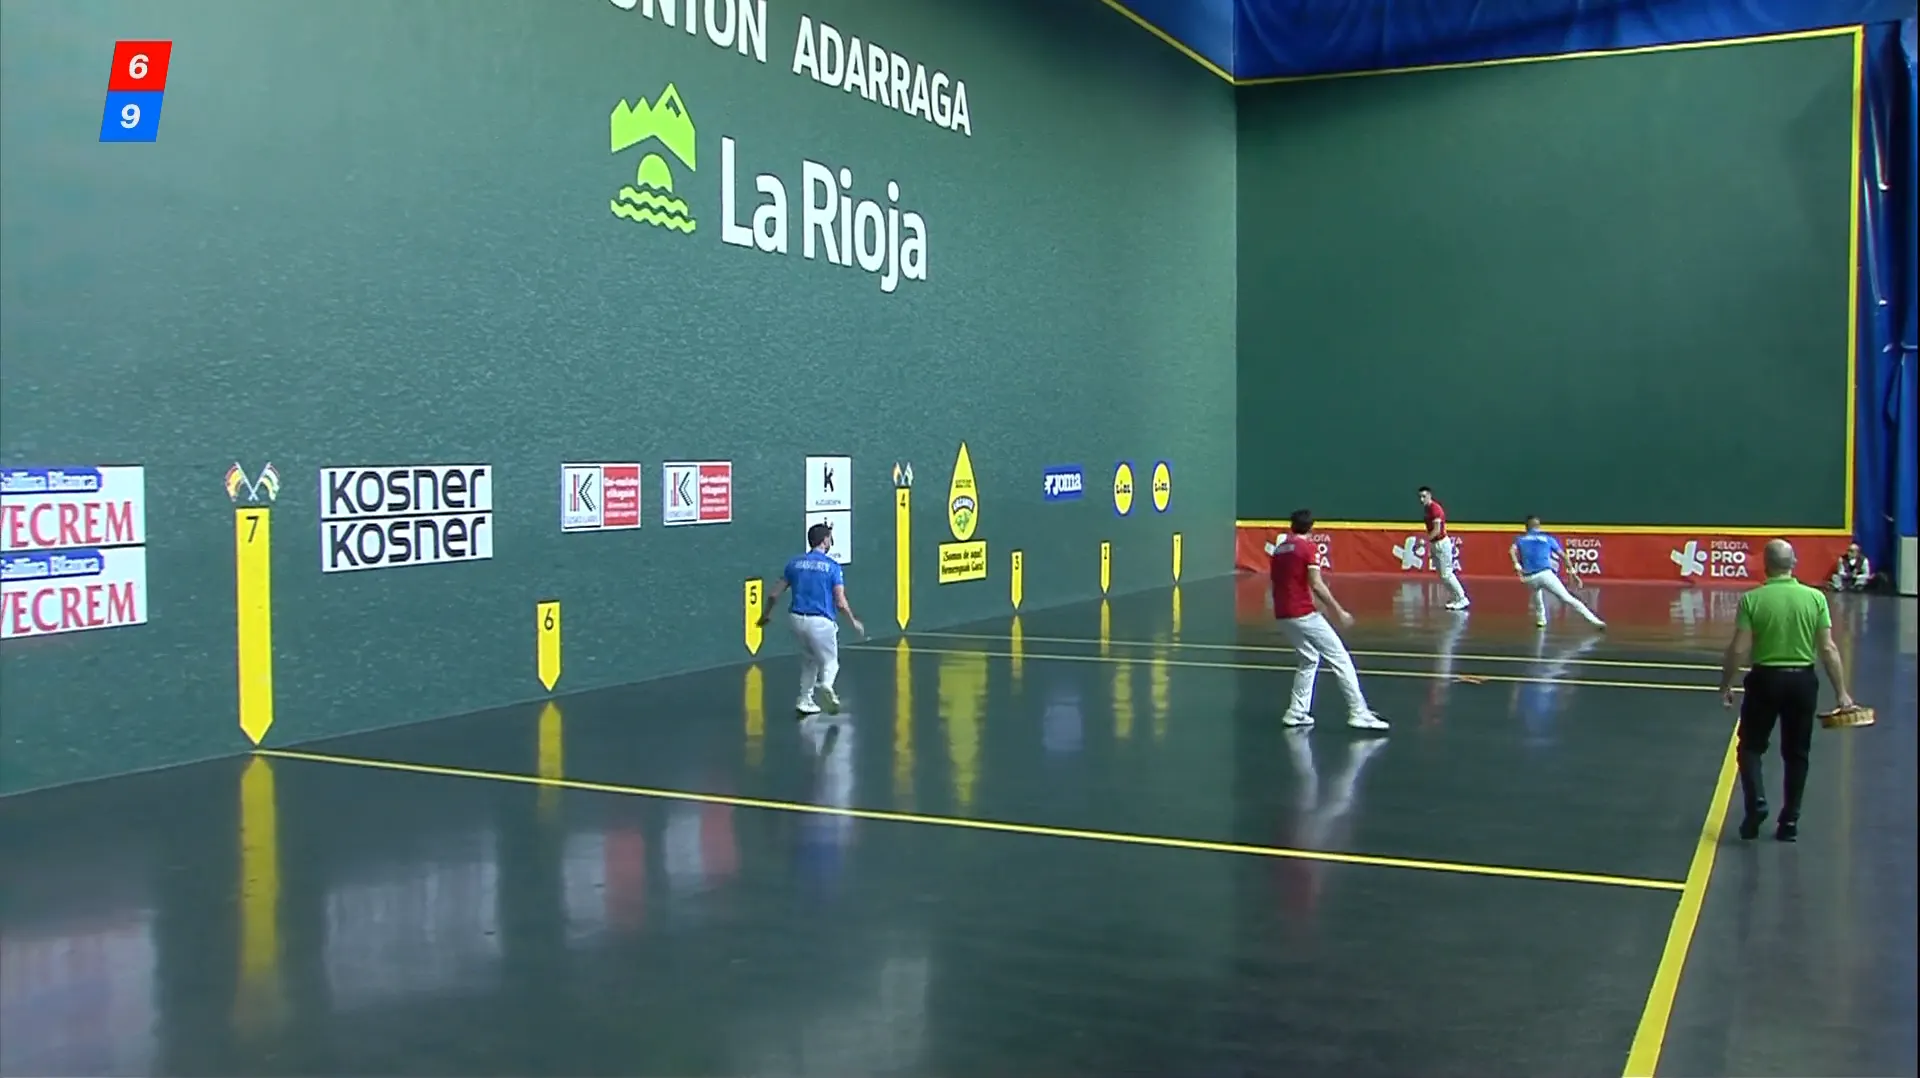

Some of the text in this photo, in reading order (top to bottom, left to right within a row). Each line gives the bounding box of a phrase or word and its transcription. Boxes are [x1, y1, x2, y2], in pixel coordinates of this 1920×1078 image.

[792, 14, 972, 136] ADARRAGA
[721, 136, 927, 293] La Rioja
[900, 493, 906, 509] 4
[245, 515, 260, 543] 7
[1566, 538, 1601, 548] PELOTA
[1711, 540, 1748, 550] PELOTA
[1566, 548, 1599, 560] PRO
[1711, 551, 1746, 563] PRO
[1711, 565, 1749, 577] LIGA
[749, 585, 758, 605] 5
[544, 608, 554, 631] 6
